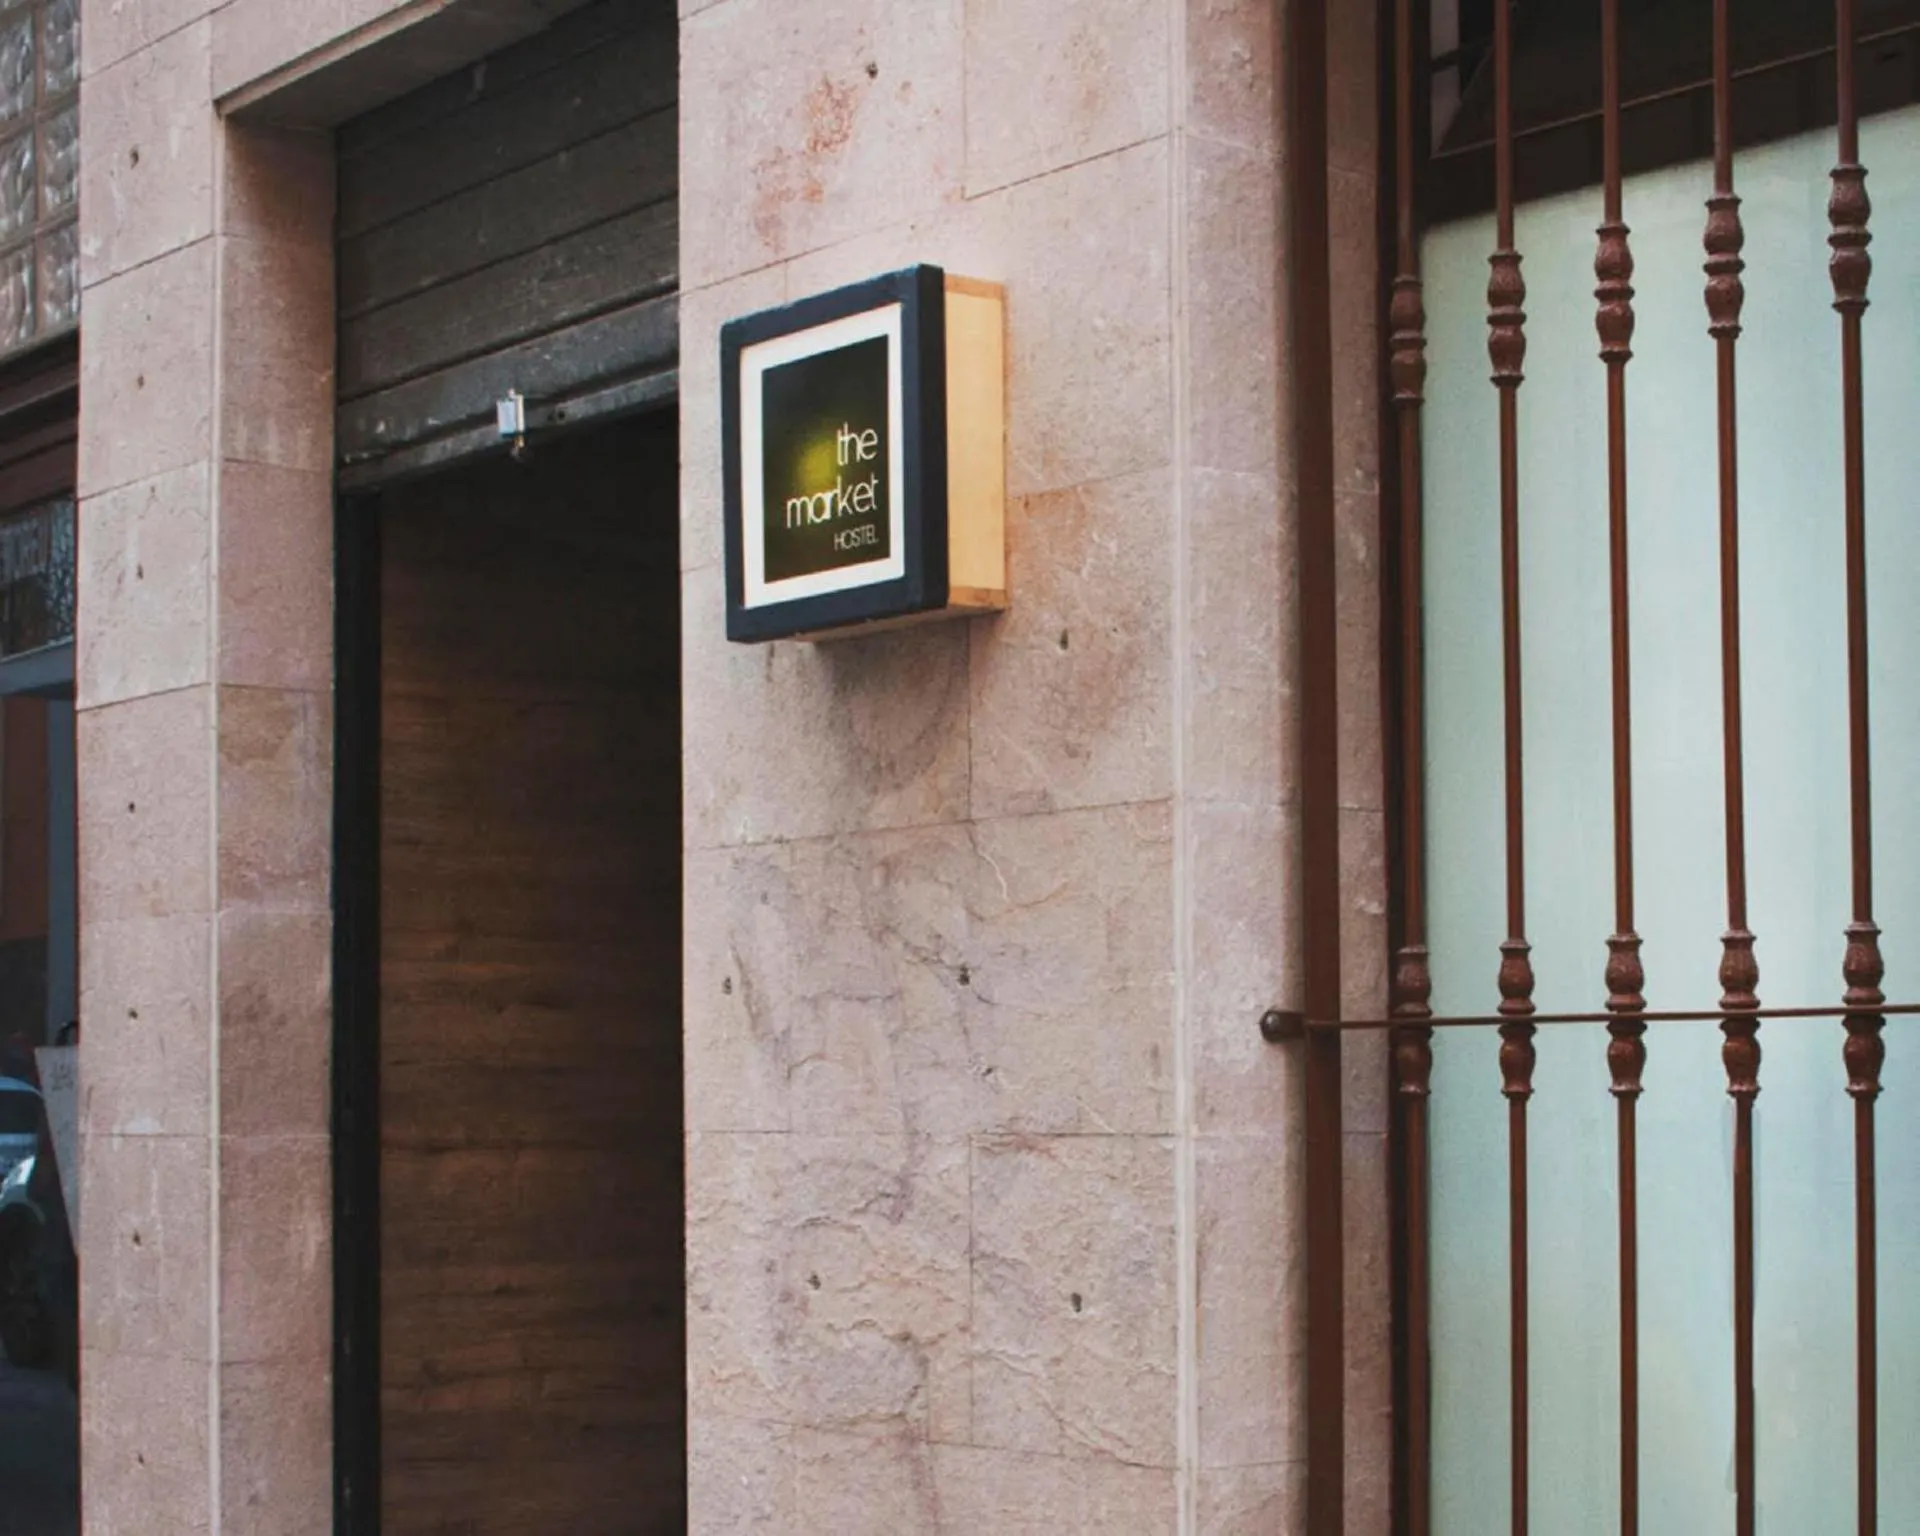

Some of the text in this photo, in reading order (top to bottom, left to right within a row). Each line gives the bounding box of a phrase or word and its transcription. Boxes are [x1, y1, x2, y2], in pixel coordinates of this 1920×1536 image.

[837, 421, 878, 466] the
[786, 472, 879, 528] market
[834, 524, 879, 550] HOSTEL
